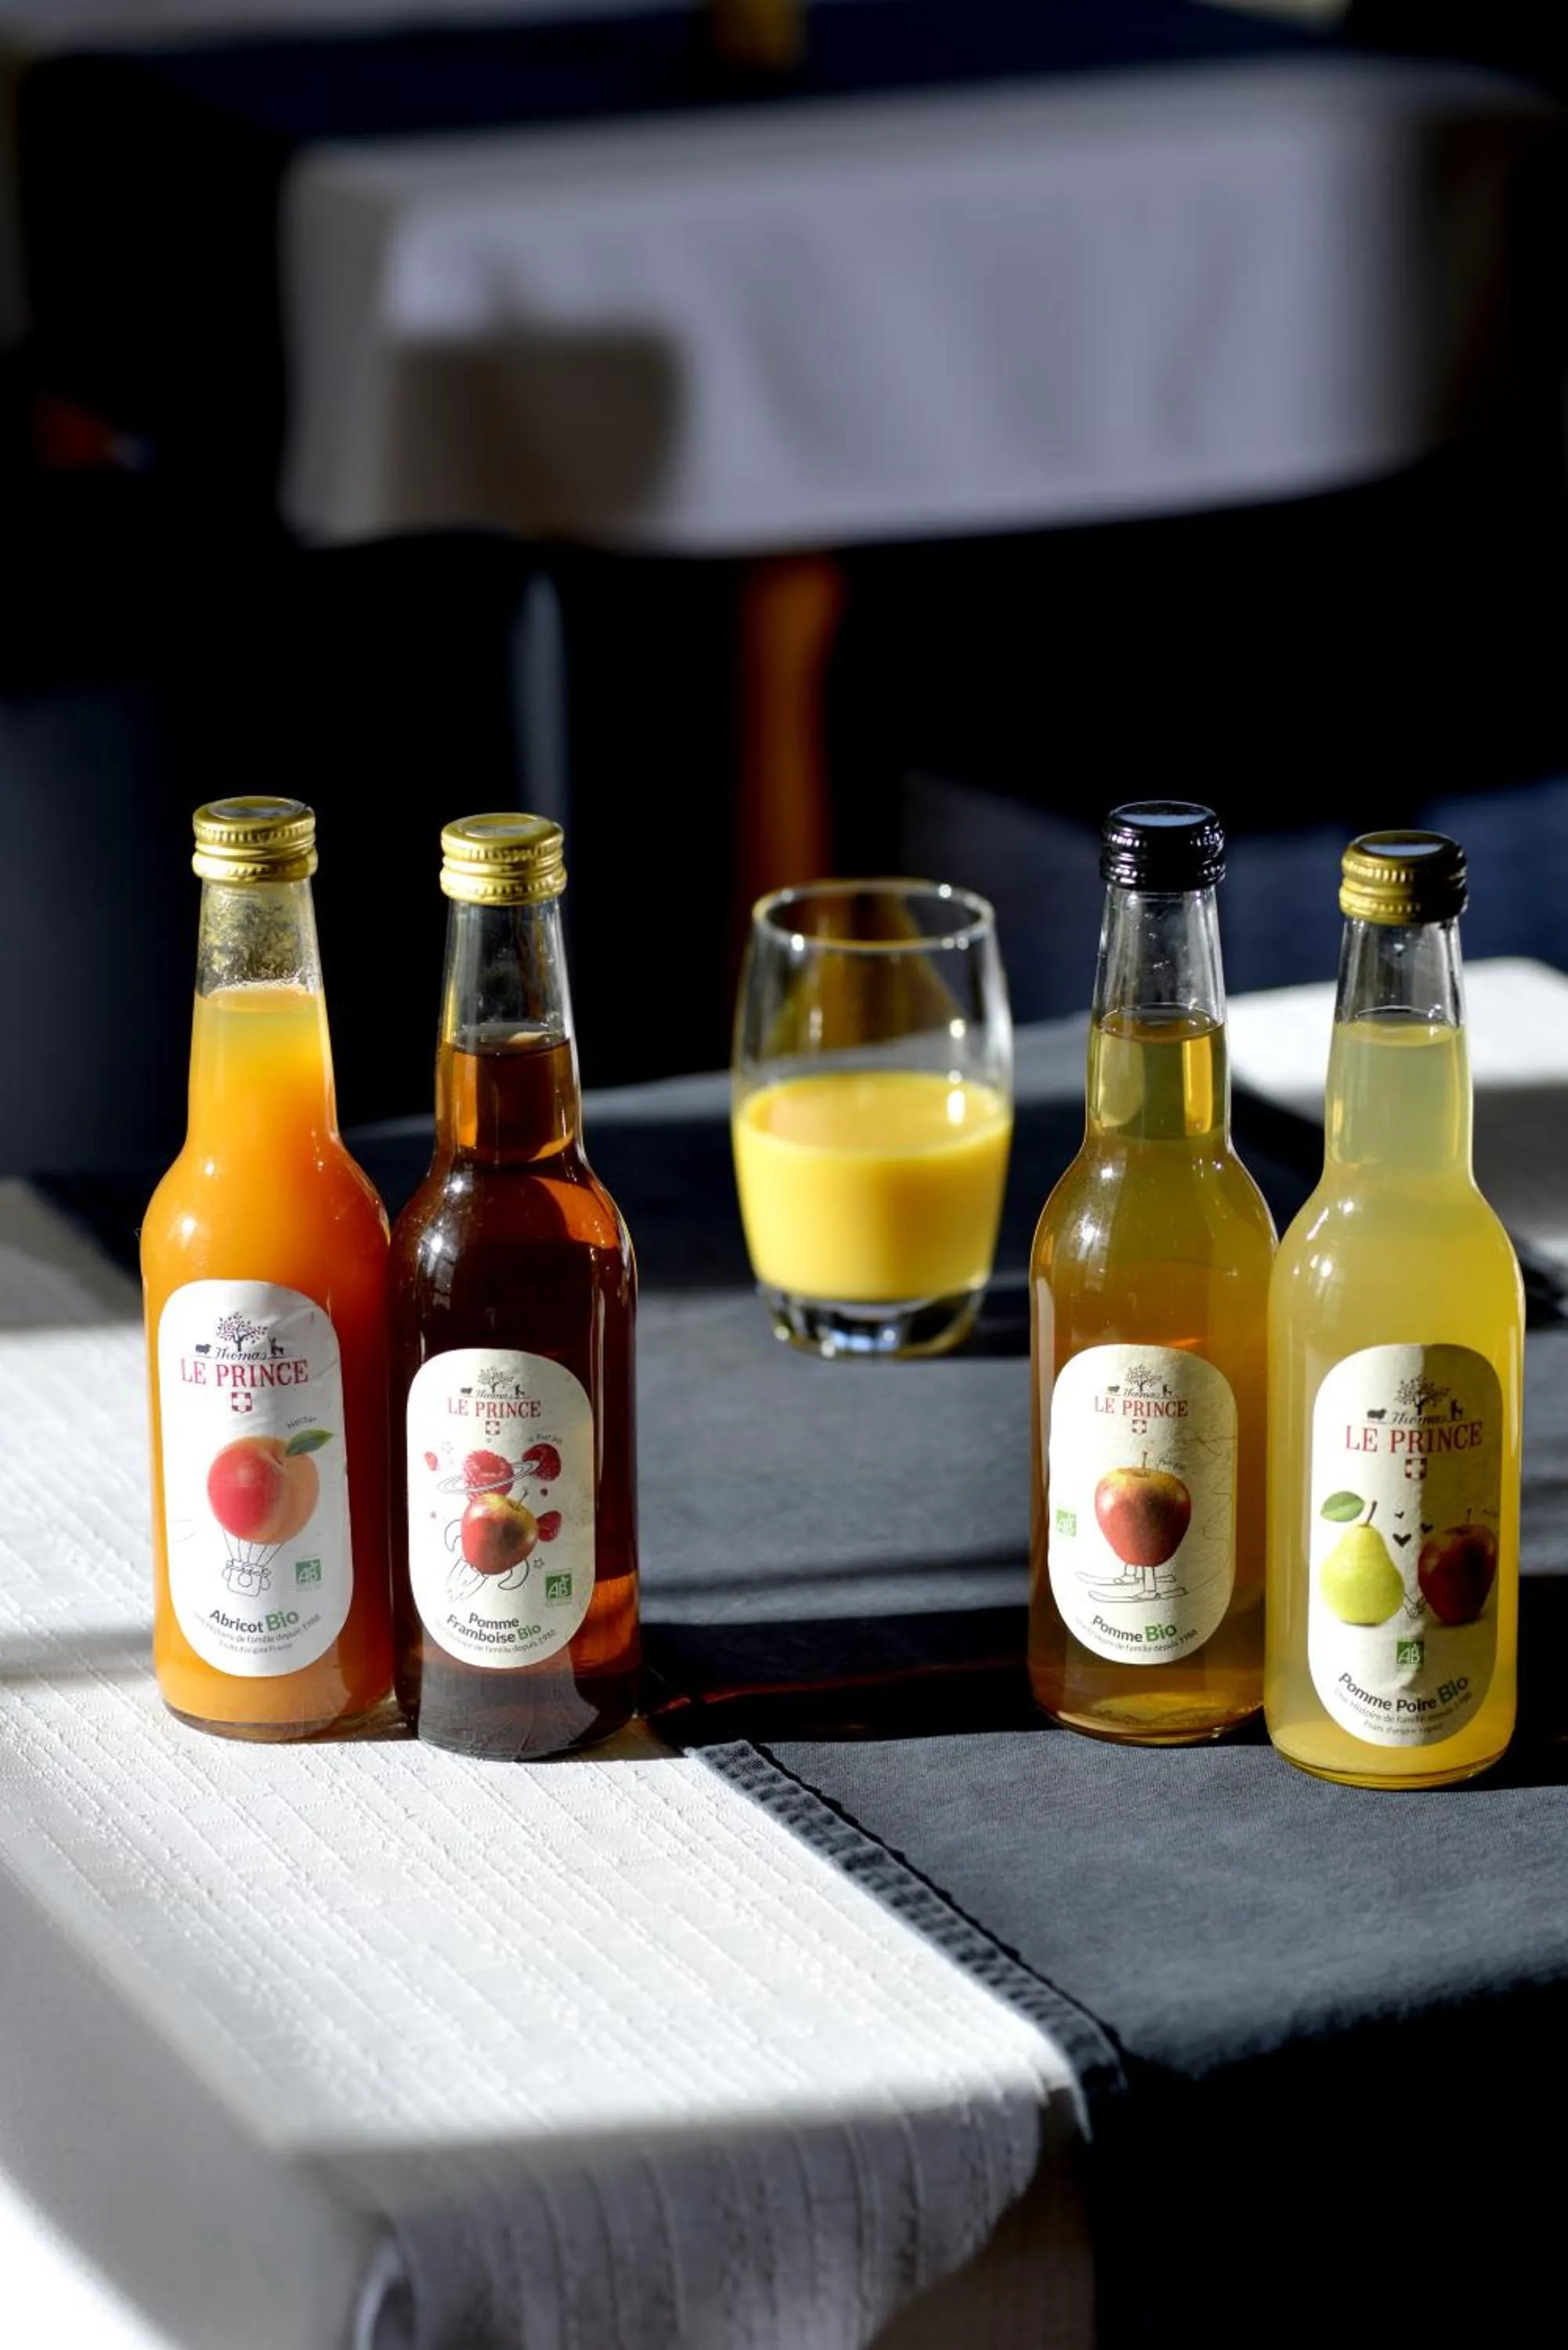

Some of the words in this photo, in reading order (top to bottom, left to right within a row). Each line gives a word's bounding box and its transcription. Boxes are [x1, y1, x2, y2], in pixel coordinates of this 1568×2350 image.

[215, 1347, 267, 1361] Thomas
[181, 1358, 206, 1385] LE
[215, 1359, 308, 1387] PRINCE
[448, 1397, 468, 1416] LE
[475, 1399, 541, 1419] PRINCE
[1094, 1396, 1115, 1414] LE
[1122, 1400, 1188, 1418] PRINCE
[1346, 1425, 1378, 1452] LE
[1390, 1420, 1483, 1454] PRINCE
[209, 1610, 264, 1633] Abricot
[265, 1611, 299, 1632] Bio
[446, 1614, 515, 1643] Framboise
[517, 1624, 541, 1640] Bio
[468, 1612, 519, 1630] Pomme
[1092, 1614, 1143, 1643] Pomme
[1144, 1623, 1178, 1643] Bio
[1398, 1643, 1420, 1663] AB
[1339, 1672, 1392, 1711] Pomme
[1396, 1697, 1437, 1713] Poire
[1437, 1676, 1469, 1705] Bio
